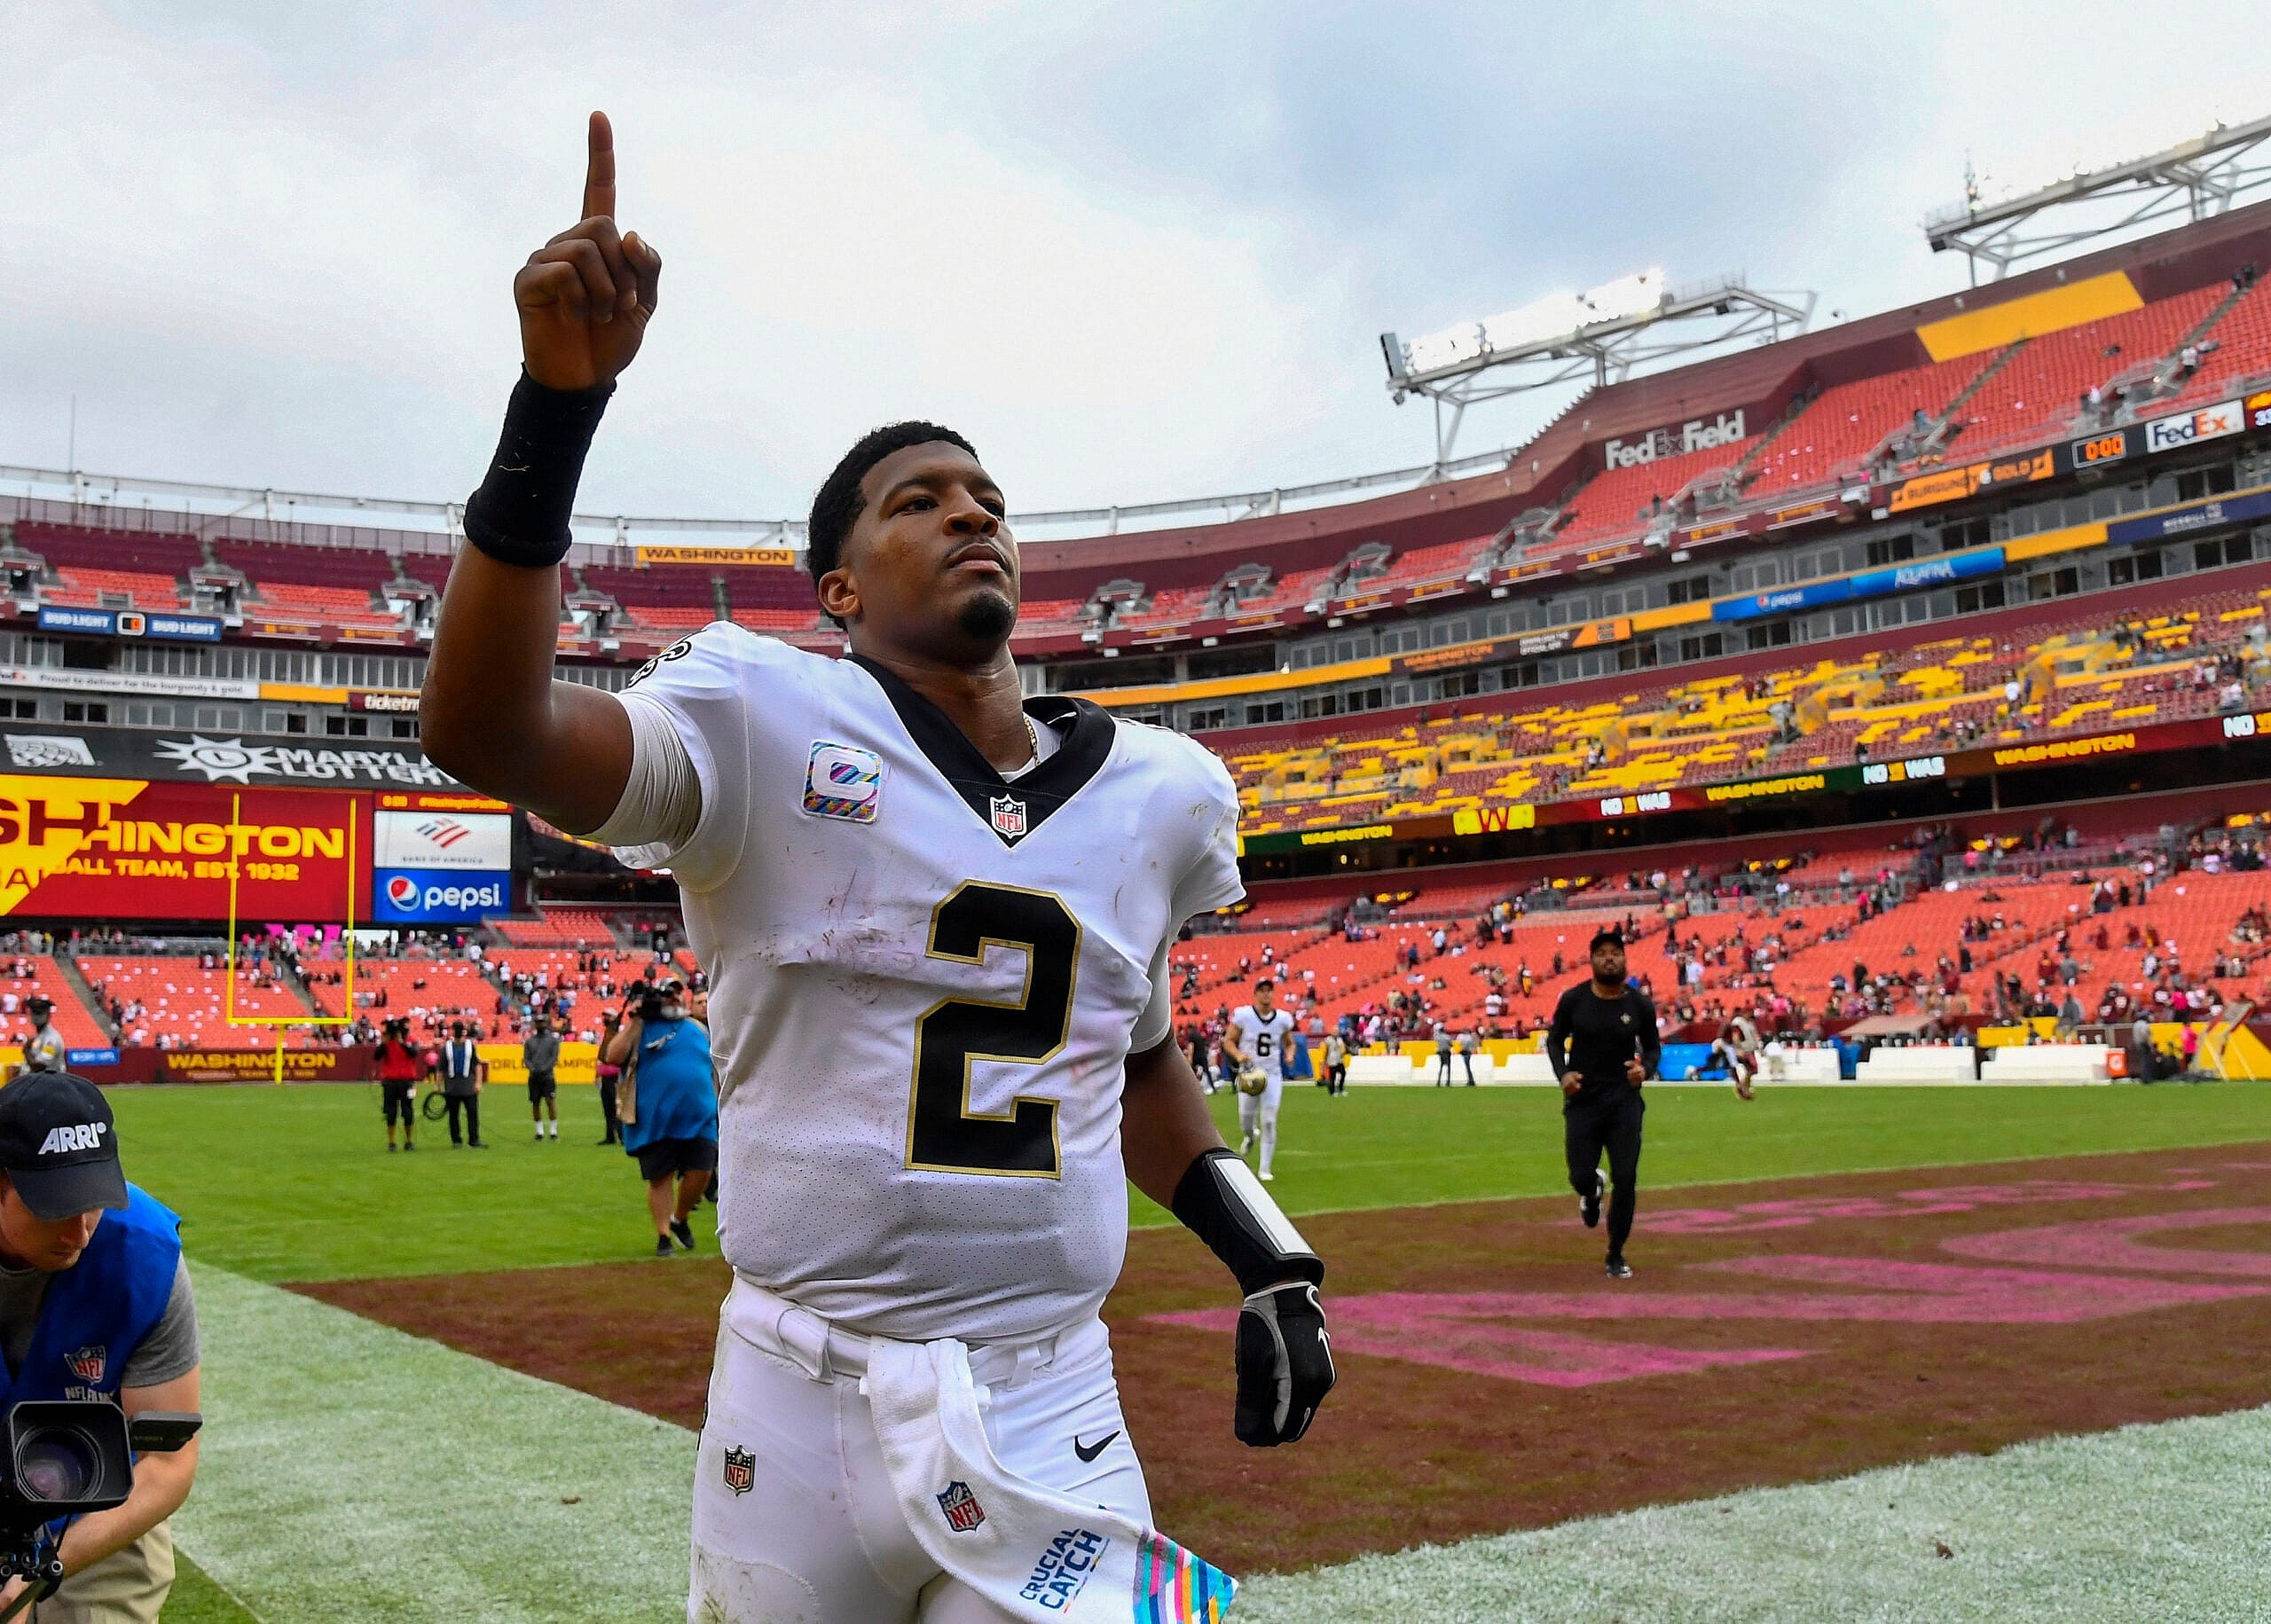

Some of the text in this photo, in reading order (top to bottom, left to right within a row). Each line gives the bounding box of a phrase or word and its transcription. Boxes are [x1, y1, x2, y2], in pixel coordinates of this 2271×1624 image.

[2153, 412, 2228, 446] FedEx
[646, 549, 788, 561] WASHINGTON
[1895, 560, 1955, 589] AQUAFINA
[44, 612, 109, 628] BUD LIGHT
[153, 619, 216, 636] BUD LIGHT
[1993, 733, 2135, 765] WASHINGTON
[811, 747, 877, 801] C
[1705, 773, 1826, 802] WASHINGTON
[996, 812, 1023, 831] NFL
[1301, 824, 1393, 846] WASHINGTON
[114, 859, 189, 880] TEAM,
[246, 863, 300, 881] 1932
[424, 883, 500, 913] pepsi
[903, 878, 1084, 1181] 2
[1257, 1032, 1271, 1057] 6
[39, 1122, 101, 1155] ARRI
[76, 1359, 104, 1380] NFL
[727, 1464, 749, 1486] NFL
[948, 1498, 985, 1529] NFL
[1019, 1528, 1080, 1600] CRUCIAL
[1039, 1529, 1103, 1609] CATCH
